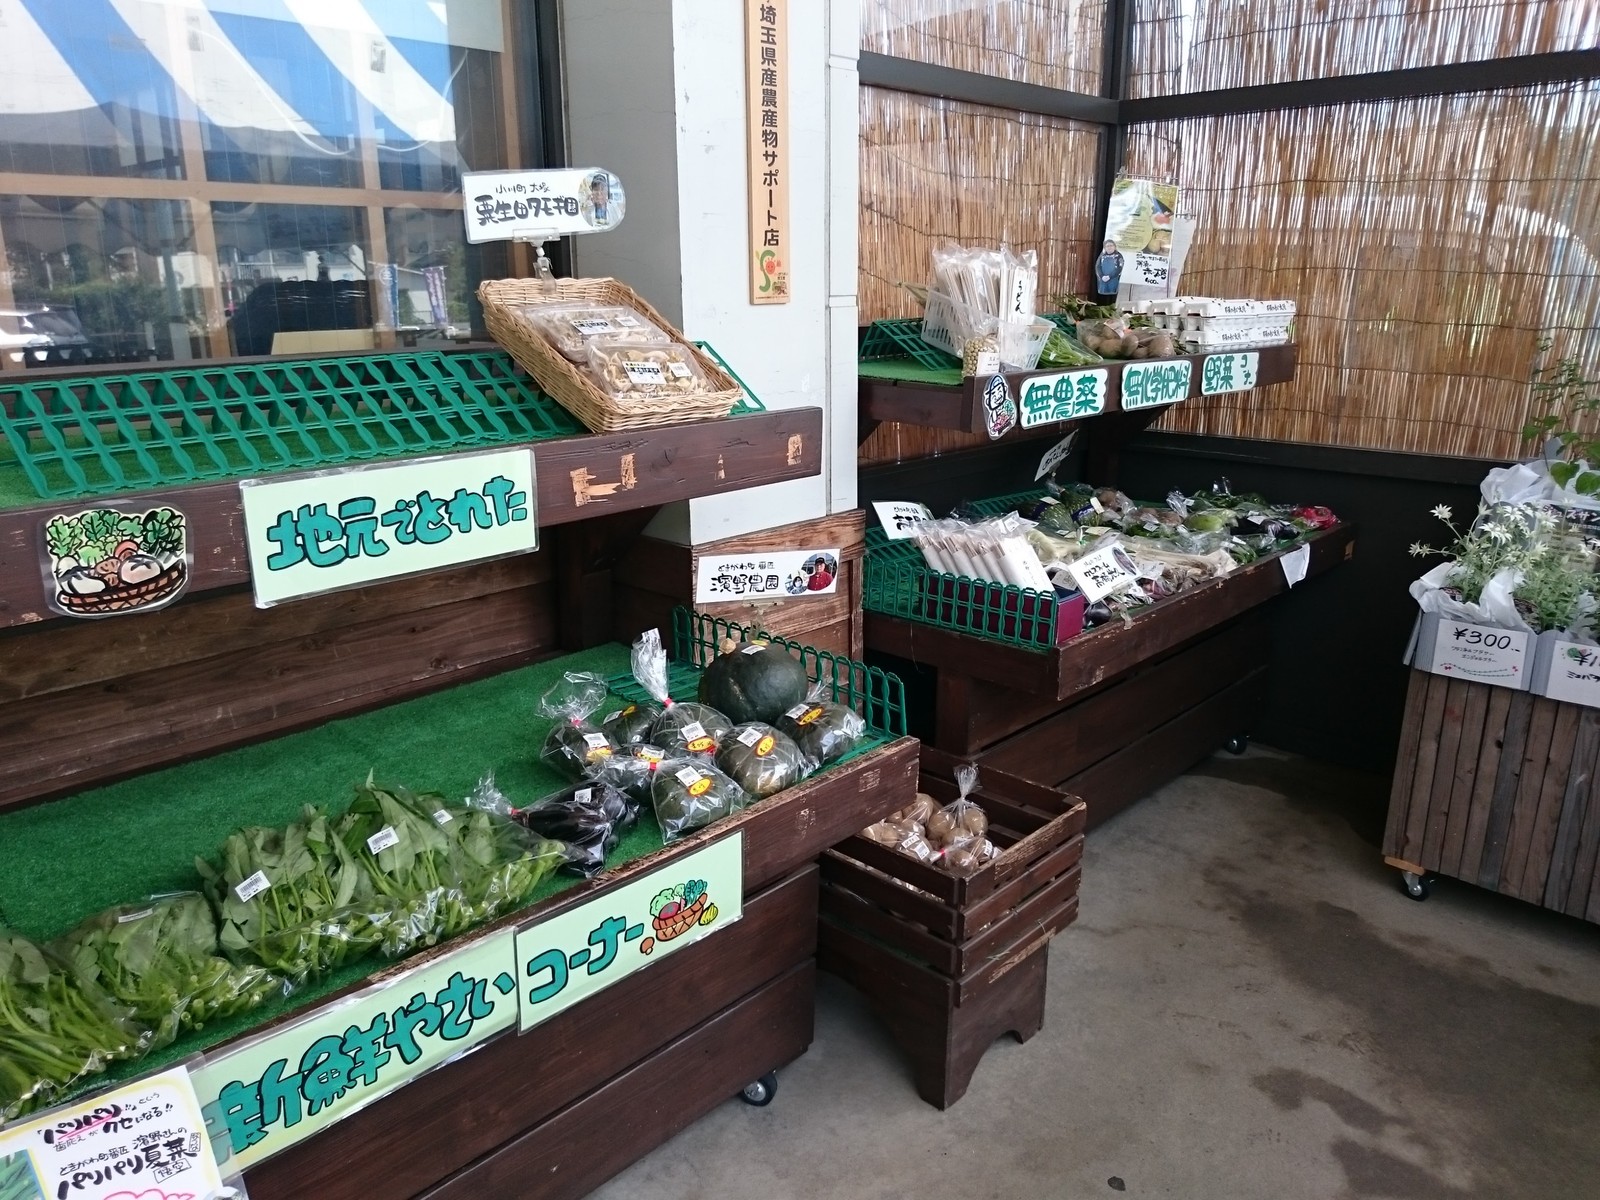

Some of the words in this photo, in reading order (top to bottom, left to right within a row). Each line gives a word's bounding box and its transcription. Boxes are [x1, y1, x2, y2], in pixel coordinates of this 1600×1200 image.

[1124, 363, 1190, 408] 無化学肥料
[1204, 354, 1235, 392] 野菜
[1023, 374, 1099, 424] 無農薬
[266, 475, 527, 571] 地元でとれた
[709, 573, 779, 594] 濱野農園
[717, 561, 755, 572] ときがわ町
[1573, 652, 1600, 667] ¥1
[526, 916, 645, 1004] コーナー
[201, 971, 516, 1166] 新鮮やさい
